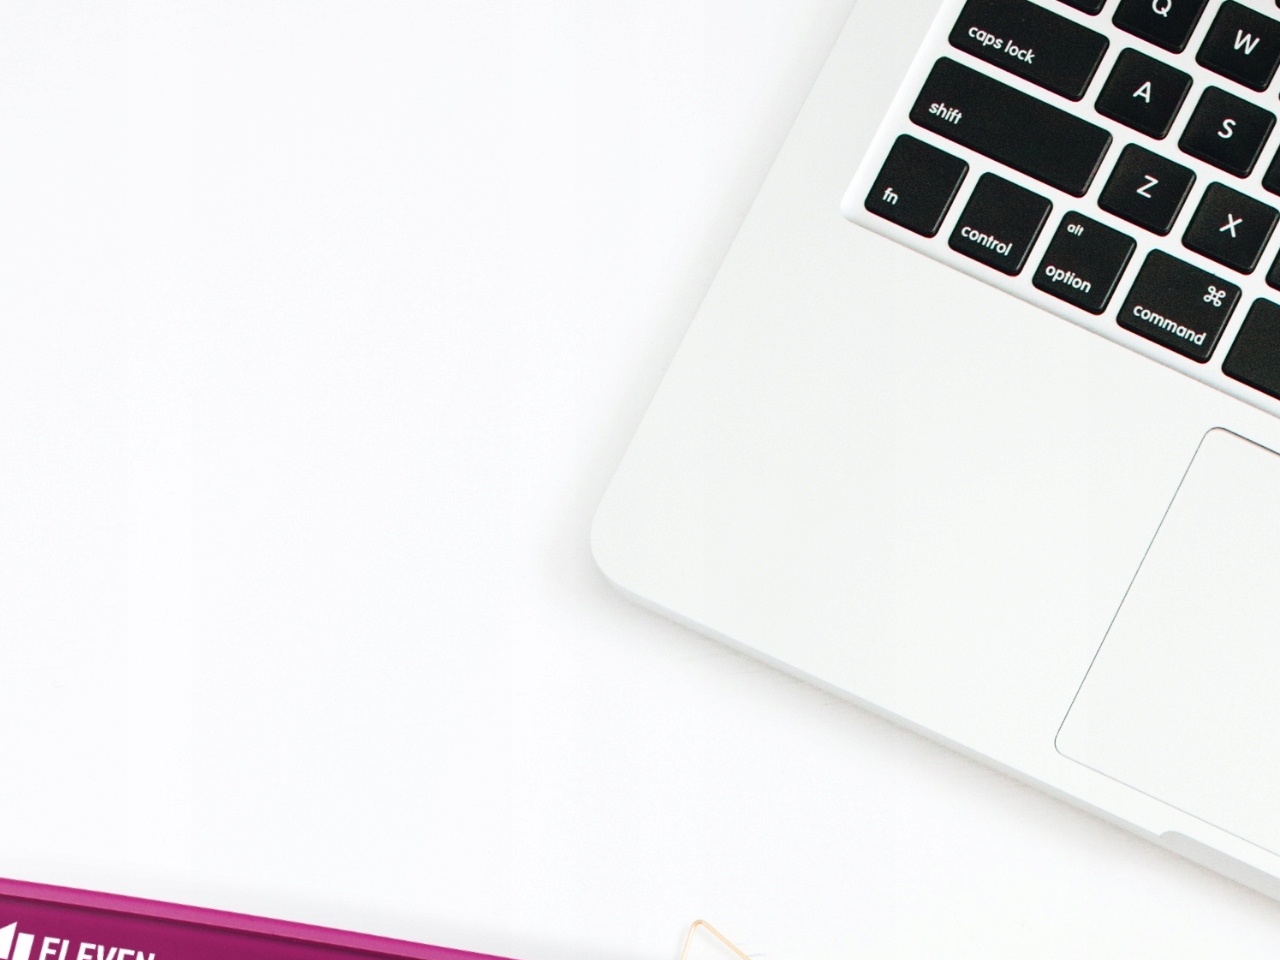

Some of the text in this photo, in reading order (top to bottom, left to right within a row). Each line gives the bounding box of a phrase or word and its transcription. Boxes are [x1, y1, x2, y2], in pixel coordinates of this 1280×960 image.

[1151, 0, 1172, 18] Q
[968, 26, 1036, 64] caps lock
[1233, 29, 1261, 55] W
[1132, 81, 1152, 104] A
[928, 102, 963, 125] shift
[1217, 118, 1237, 139] S
[882, 187, 899, 205] fn
[1136, 174, 1159, 199] Z
[1066, 222, 1085, 237] alt
[1219, 213, 1243, 238] X
[960, 224, 1013, 256] control
[1045, 264, 1092, 293] option
[1132, 303, 1207, 347] command
